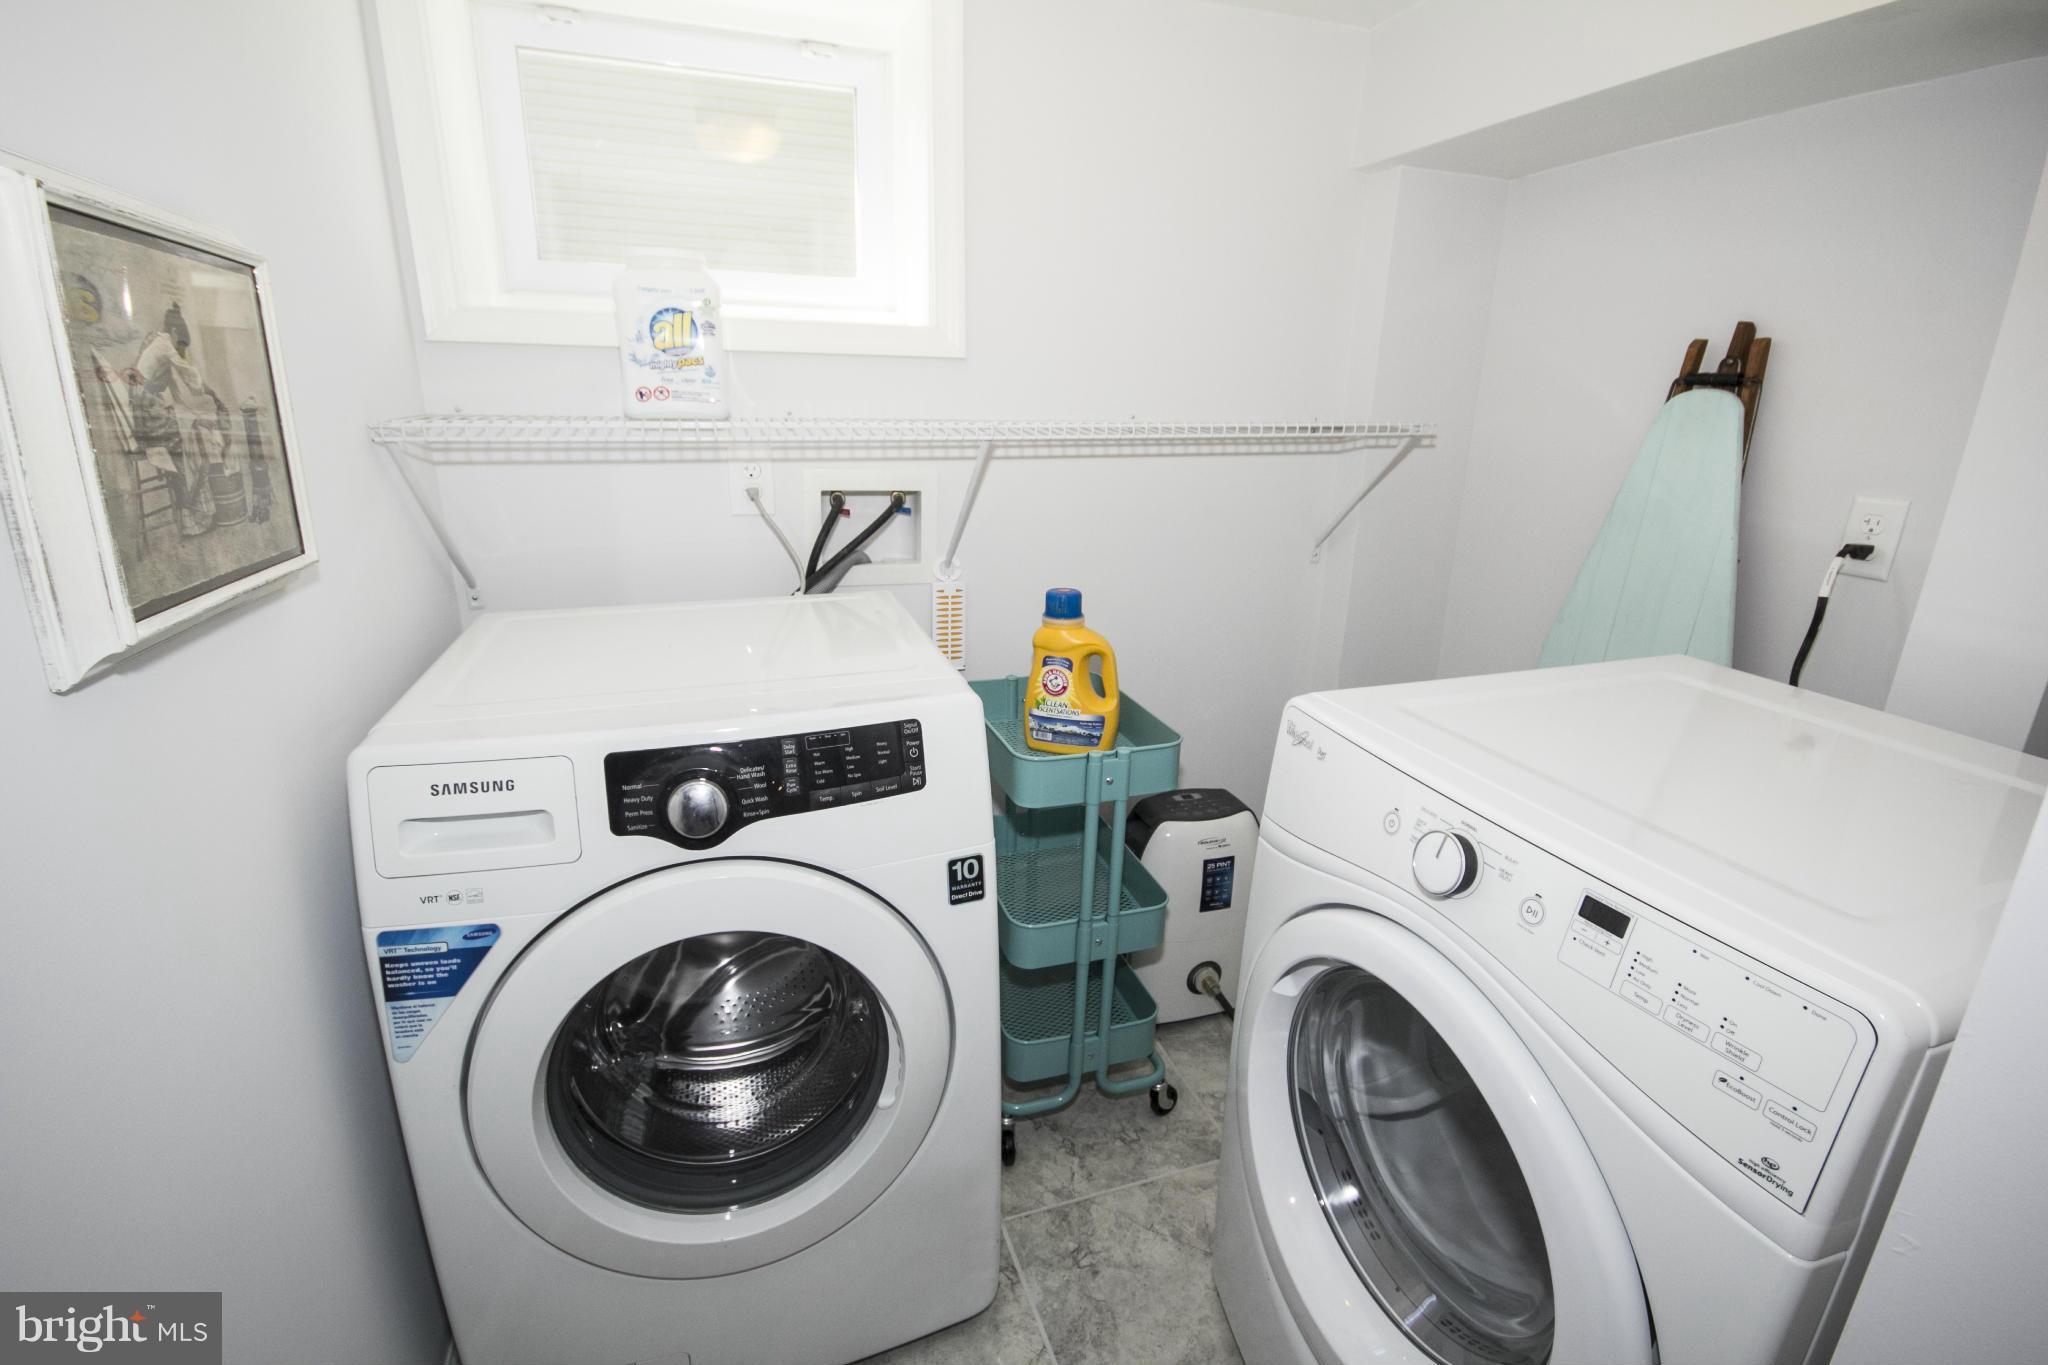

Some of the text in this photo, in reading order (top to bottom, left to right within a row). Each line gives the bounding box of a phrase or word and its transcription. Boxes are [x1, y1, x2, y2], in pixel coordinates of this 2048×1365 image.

[652, 310, 693, 351] all
[1045, 699, 1069, 709] CLEAN
[1039, 706, 1080, 716] SCENTSATIONS
[903, 721, 918, 729] Signal
[903, 727, 919, 735] On/Off
[430, 779, 515, 797] SAMSUNG
[622, 783, 642, 791] Normal
[851, 790, 862, 798] Spin
[627, 824, 648, 832] Sanitize
[952, 858, 980, 881] 10
[951, 881, 982, 891] WARRANTY
[419, 895, 440, 904] VRT
[448, 893, 461, 902] NSF
[951, 892, 968, 901] Direct
[403, 945, 442, 954] Technology
[1638, 960, 1659, 974] Medium
[386, 975, 412, 983] hardly
[387, 981, 417, 989] washer
[1753, 979, 1782, 998] Cool Down
[1683, 985, 1697, 996] More
[1677, 1001, 1688, 1011] Less
[1811, 1009, 1828, 1021] Done
[1675, 1012, 1700, 1030] Dryness
[1729, 1019, 1738, 1028] On
[1677, 1020, 1694, 1033] Level
[1725, 1028, 1736, 1036] Off
[1725, 1039, 1750, 1058] Wrinkle
[1725, 1047, 1745, 1062] Shield
[1725, 1081, 1757, 1104] EcoBoost
[1768, 1106, 1812, 1136] Control Lock
[1737, 1157, 1795, 1198] SensorDrying
[1761, 1164, 1787, 1184] efficiency
